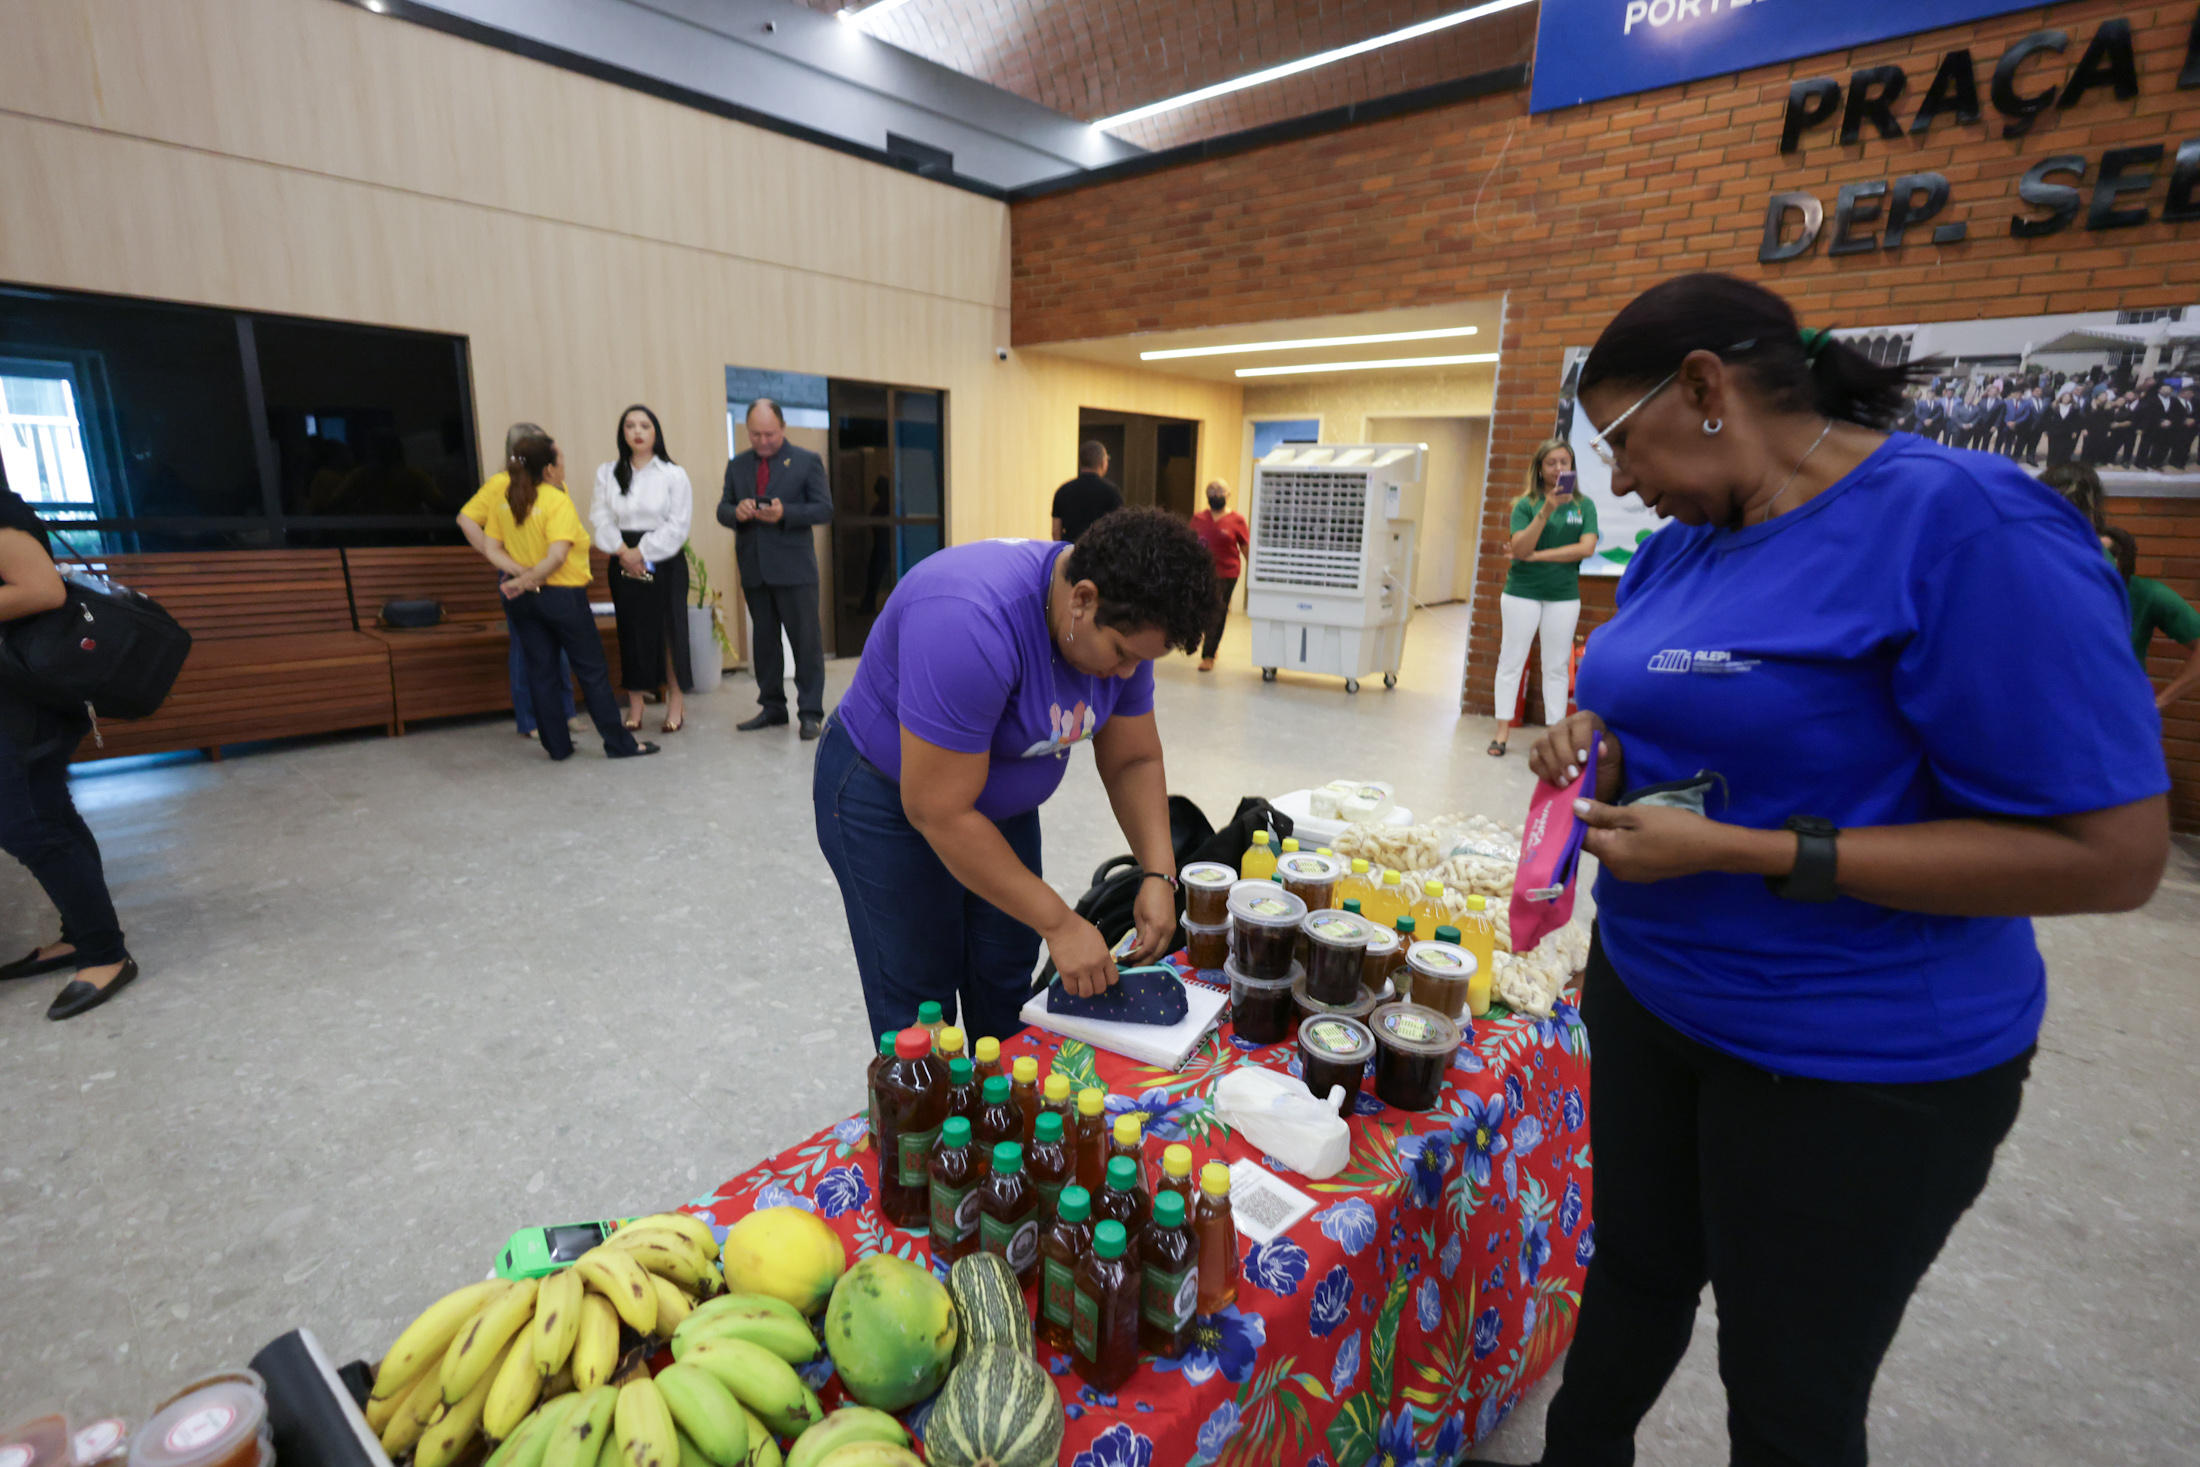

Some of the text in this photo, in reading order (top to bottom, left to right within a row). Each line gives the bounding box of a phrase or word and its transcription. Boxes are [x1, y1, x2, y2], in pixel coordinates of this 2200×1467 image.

[1780, 18, 2139, 155] PRAÇA
[1758, 172, 1967, 264] DEP.
[1693, 650, 1731, 661] ALEPI
